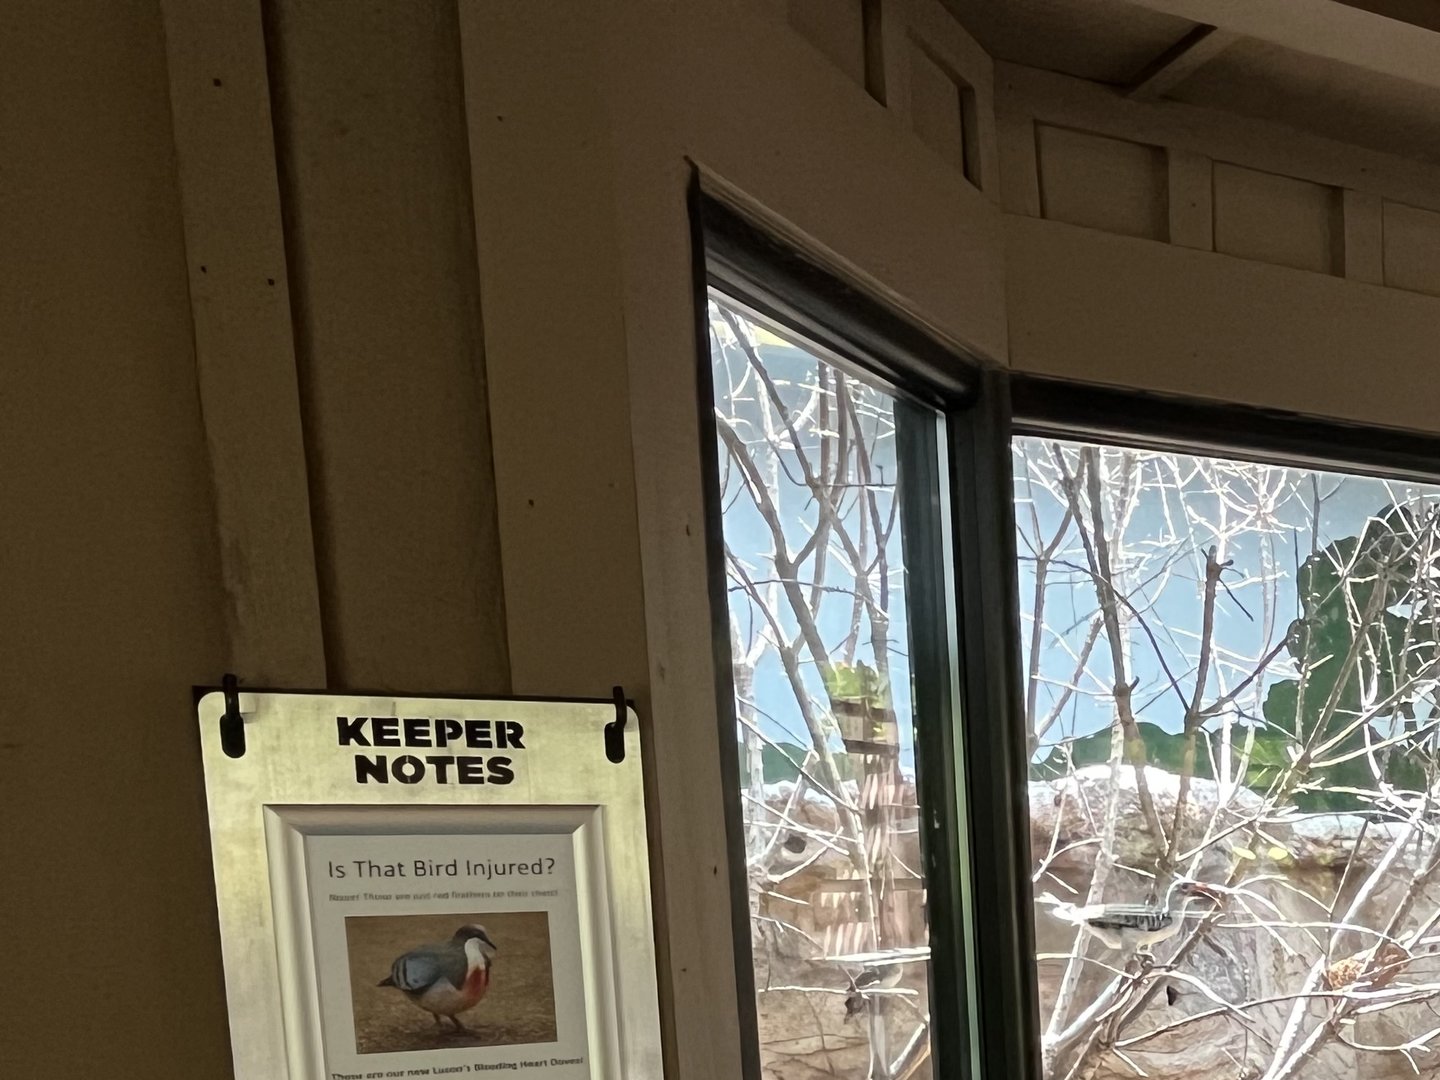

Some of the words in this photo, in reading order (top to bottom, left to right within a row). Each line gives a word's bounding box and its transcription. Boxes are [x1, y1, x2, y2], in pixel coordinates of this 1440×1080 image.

[336, 716, 526, 749] KEEPER
[354, 754, 515, 785] NOTES
[328, 861, 346, 879] Is
[352, 859, 407, 878] That
[414, 859, 458, 877] Bird
[466, 857, 556, 880] Injured?
